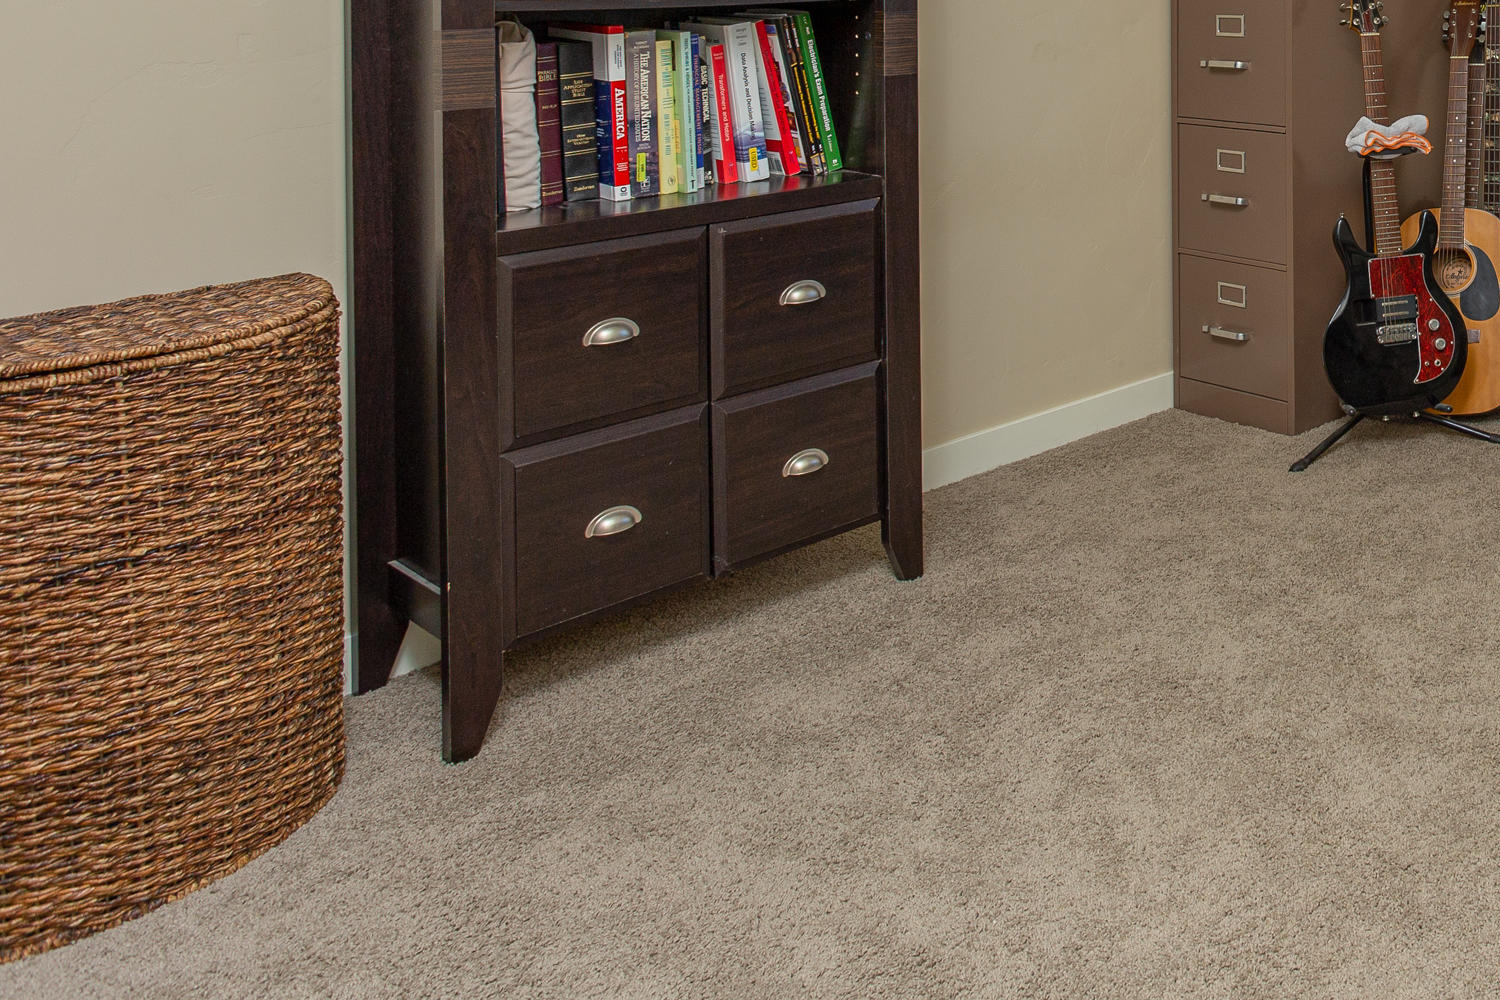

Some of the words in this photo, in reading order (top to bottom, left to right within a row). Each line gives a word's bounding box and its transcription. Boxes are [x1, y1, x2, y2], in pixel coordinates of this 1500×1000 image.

[640, 51, 650, 68] THE
[692, 54, 700, 87] FINANCIAL
[700, 65, 708, 85] BASIC
[807, 39, 822, 78] Electrician's
[640, 68, 651, 109] AMERICAN
[718, 73, 727, 110] Transformers
[742, 66, 750, 86] Analysis
[746, 98, 754, 120] Decision
[815, 78, 824, 95] Exam
[614, 87, 625, 140] AMERICA
[701, 88, 710, 122] TECHNICAL
[818, 95, 832, 131] Preparation
[640, 110, 652, 141] NATION
